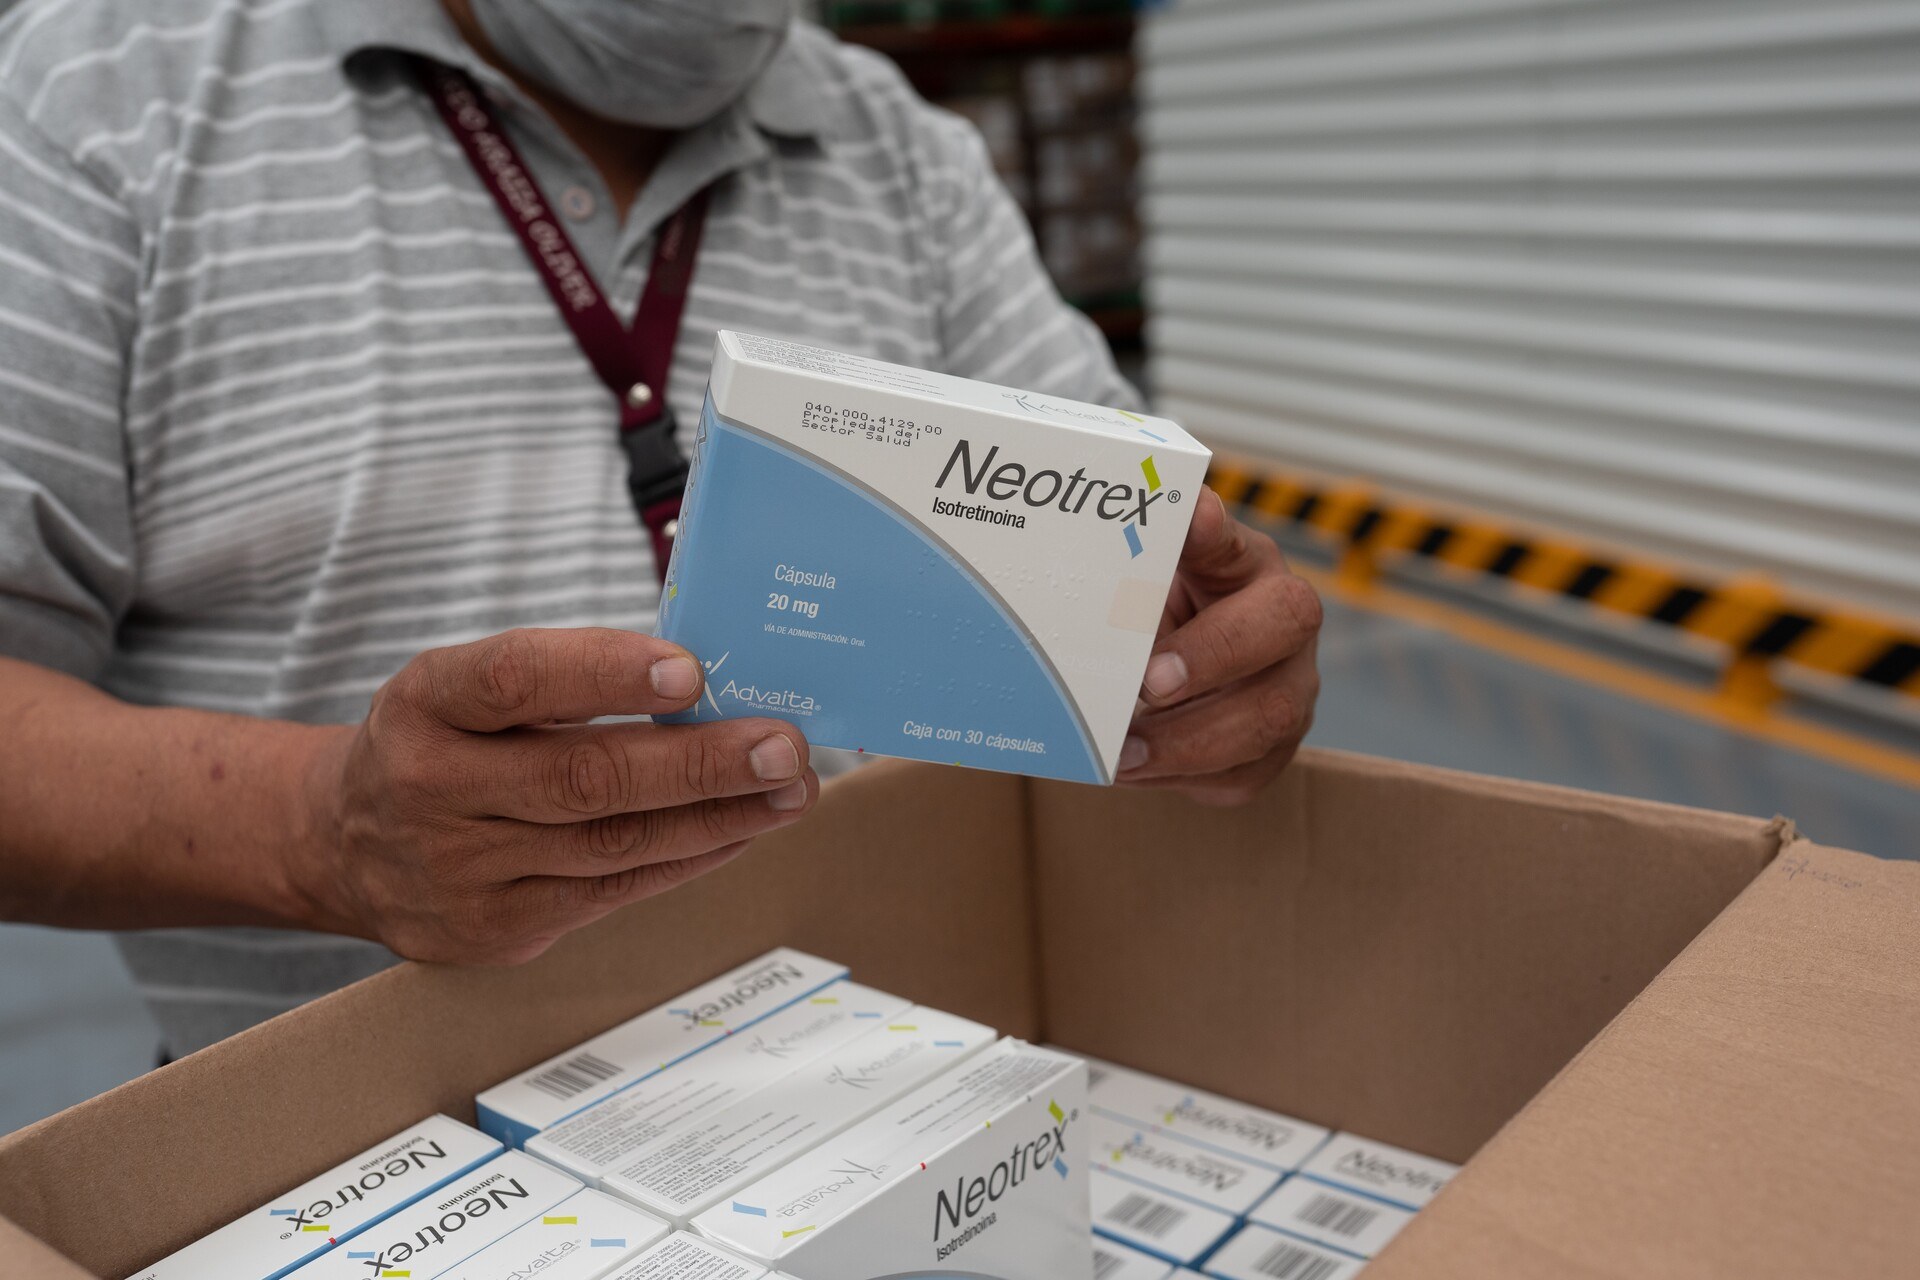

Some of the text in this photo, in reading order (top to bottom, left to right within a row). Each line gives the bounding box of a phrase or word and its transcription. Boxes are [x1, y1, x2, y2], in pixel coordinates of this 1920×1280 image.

[802, 418, 911, 447] Sector Salud
[803, 410, 920, 440] Propiedad del
[805, 401, 942, 436] 040.000.4129.00
[935, 438, 1164, 526] Neotrex
[932, 496, 1026, 530] Isotretinoina
[774, 564, 836, 590] Cápsula
[766, 593, 820, 619] 20 mg
[764, 623, 776, 634] VÍA
[776, 626, 787, 635] DE
[787, 627, 850, 646] ADMINISTRACIÓN:
[719, 680, 815, 710] Advaita
[747, 701, 813, 716] Pharmaceuticals
[903, 720, 1047, 754] Caja con 30 cápsulas.
[360, 1136, 425, 1171] Isotretinoina
[286, 1140, 447, 1232] Neotrex
[438, 1173, 505, 1211] Isotretinoina
[783, 1176, 855, 1217] Advaita
[933, 1118, 1069, 1242] Neotrex
[363, 1178, 529, 1277] Neotrex
[936, 1212, 997, 1262] Isotretinoina
[506, 1240, 576, 1280] dvaita
